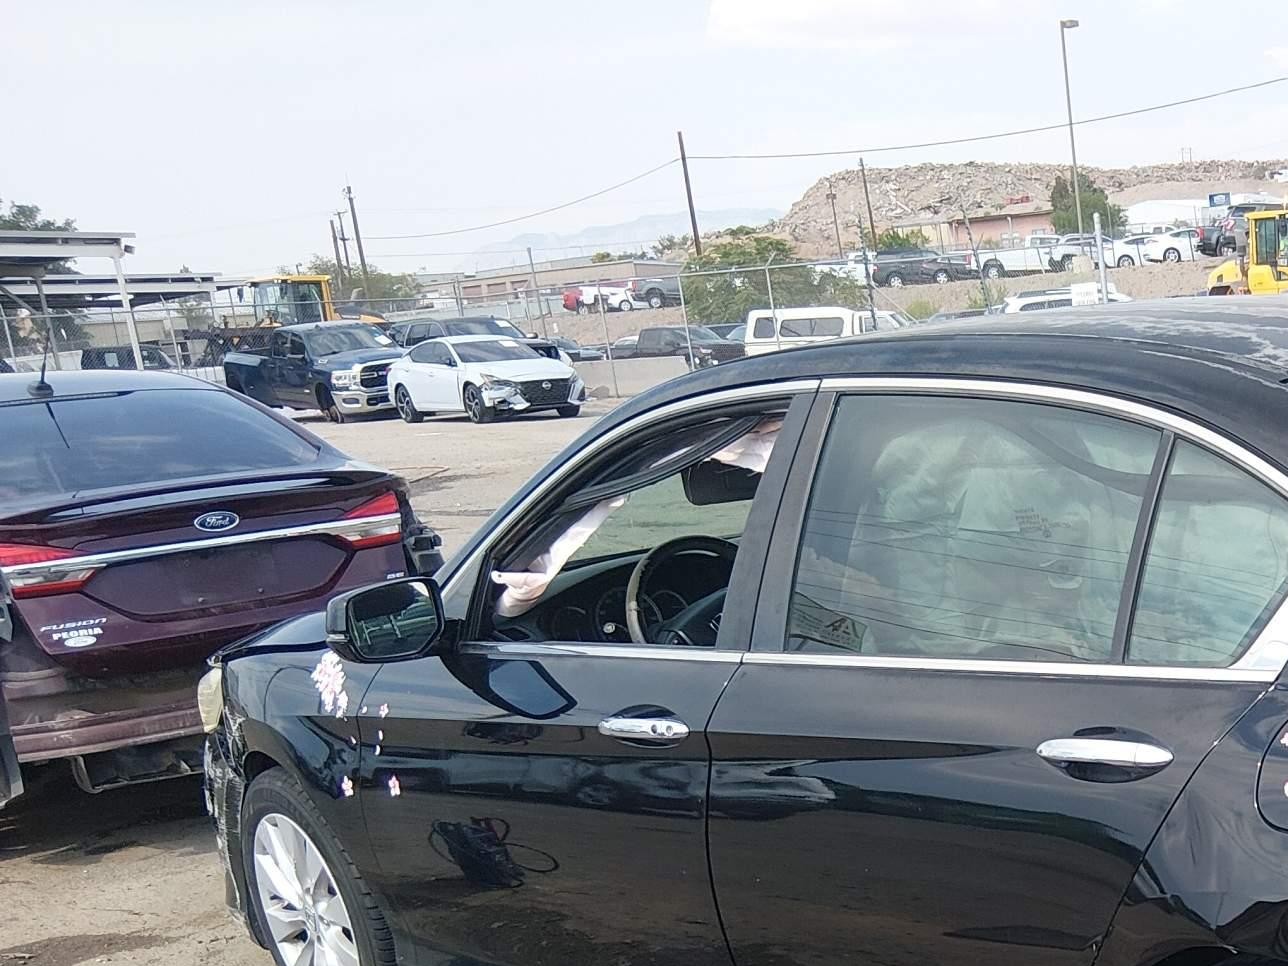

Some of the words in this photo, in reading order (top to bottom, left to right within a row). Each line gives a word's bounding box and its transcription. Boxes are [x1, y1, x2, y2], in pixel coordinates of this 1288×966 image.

[205, 515, 230, 527] Ford
[40, 617, 107, 632] FUSION
[52, 627, 104, 641] PEORIA
